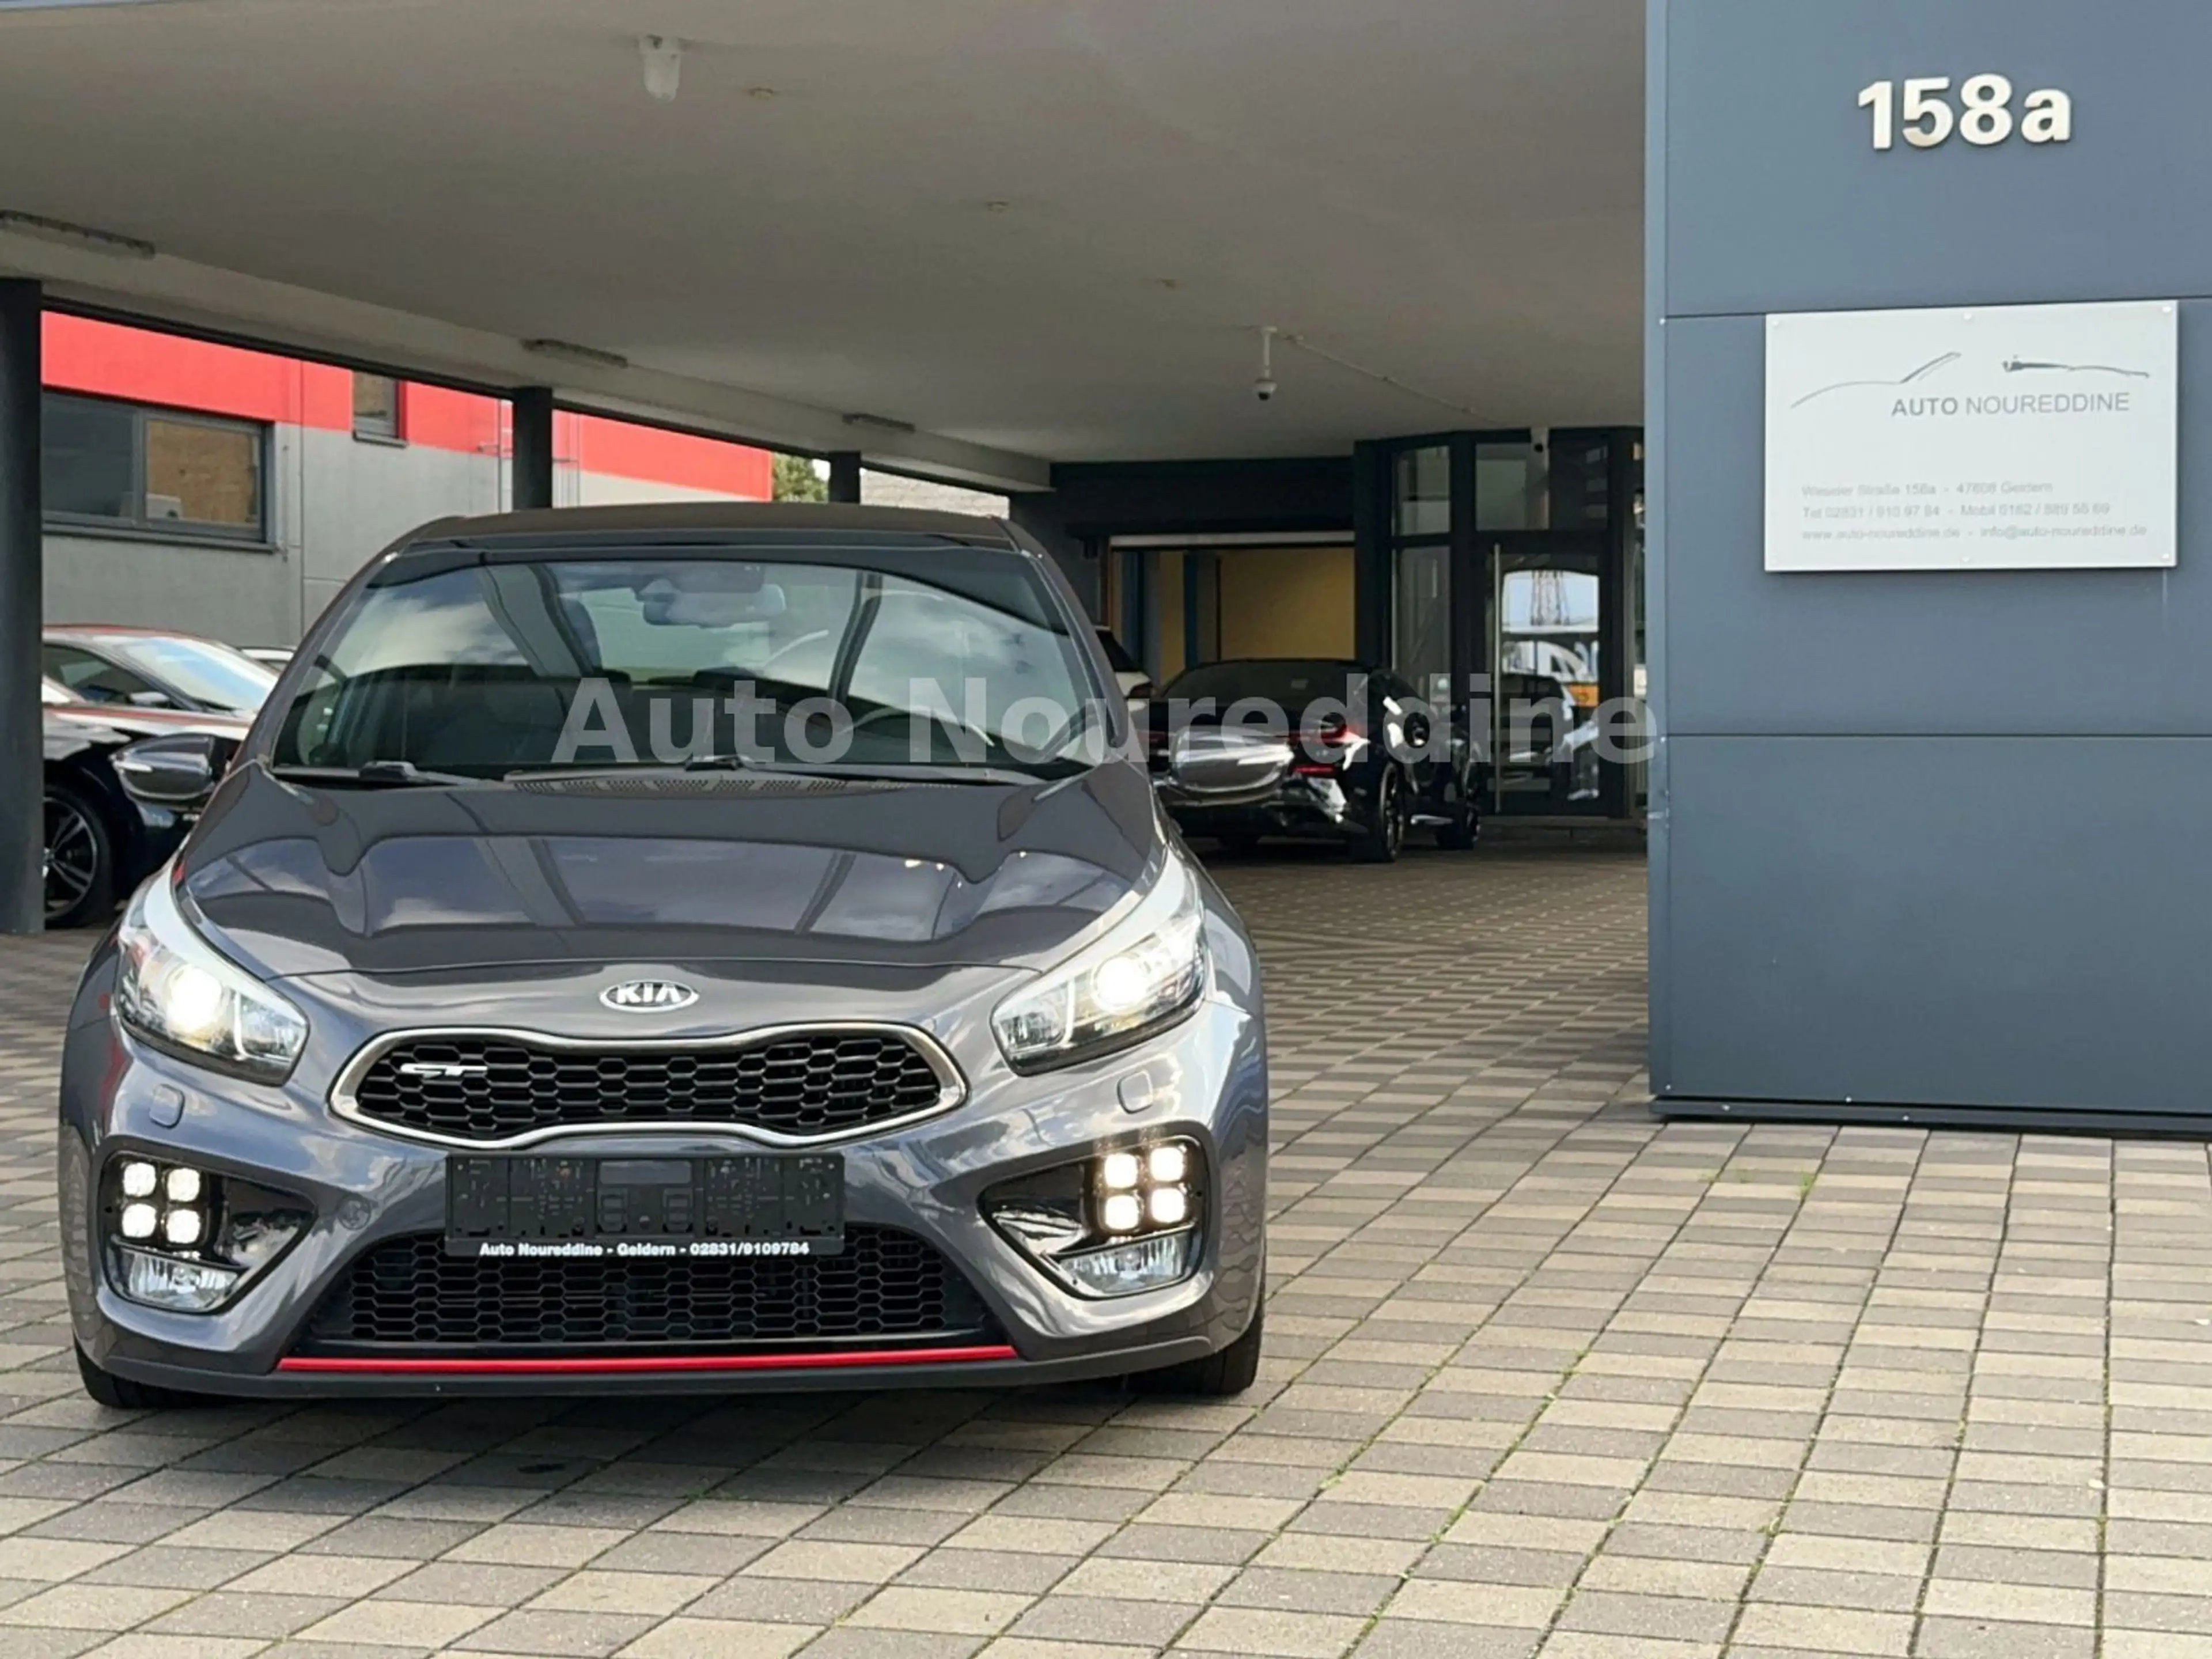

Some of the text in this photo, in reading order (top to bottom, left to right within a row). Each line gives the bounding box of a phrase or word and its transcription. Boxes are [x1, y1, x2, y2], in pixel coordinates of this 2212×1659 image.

[1858, 73, 2071, 149] 158a
[1891, 392, 2130, 416] AUTO NOUREDDINE
[616, 982, 681, 1003] KIA
[480, 1242, 514, 1256] Auto
[518, 1242, 604, 1256] Noureddine
[617, 1242, 676, 1256] Geldern
[690, 1241, 809, 1256] 02831/9109784
